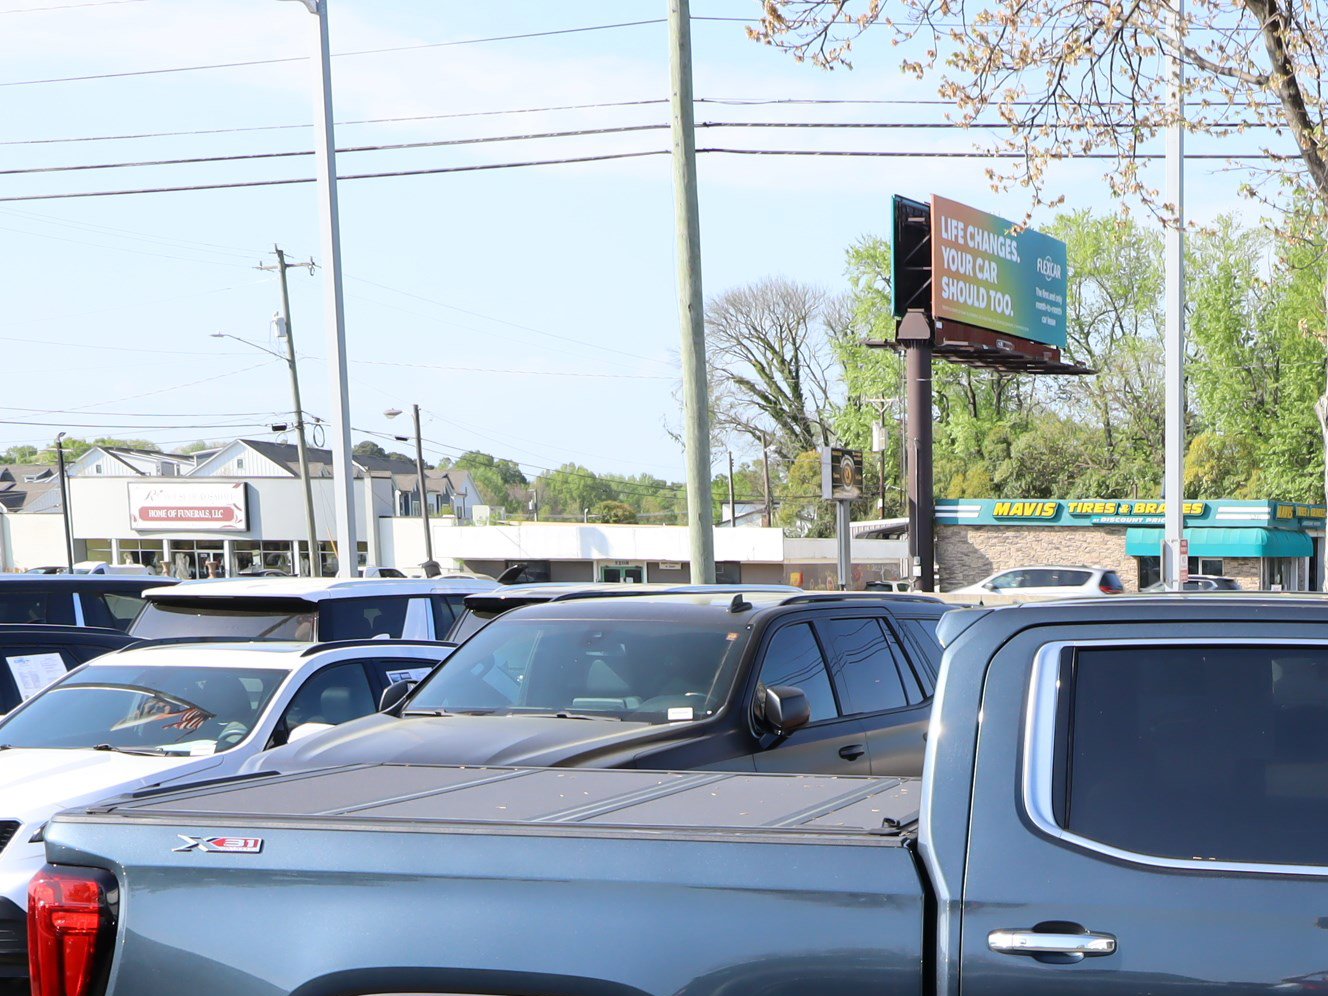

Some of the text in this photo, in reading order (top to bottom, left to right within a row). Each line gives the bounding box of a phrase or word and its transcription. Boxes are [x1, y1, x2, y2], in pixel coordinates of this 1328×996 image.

[941, 215, 1020, 263] LIFE CHANGES.
[941, 245, 998, 284] YOUR CAR
[942, 276, 1014, 317] SHOULD TOO.
[148, 509, 224, 519] HOME OF FUNERALS, LLC
[993, 502, 1205, 517] MAVIS TIRES & BRAES
[171, 834, 263, 854] X31
